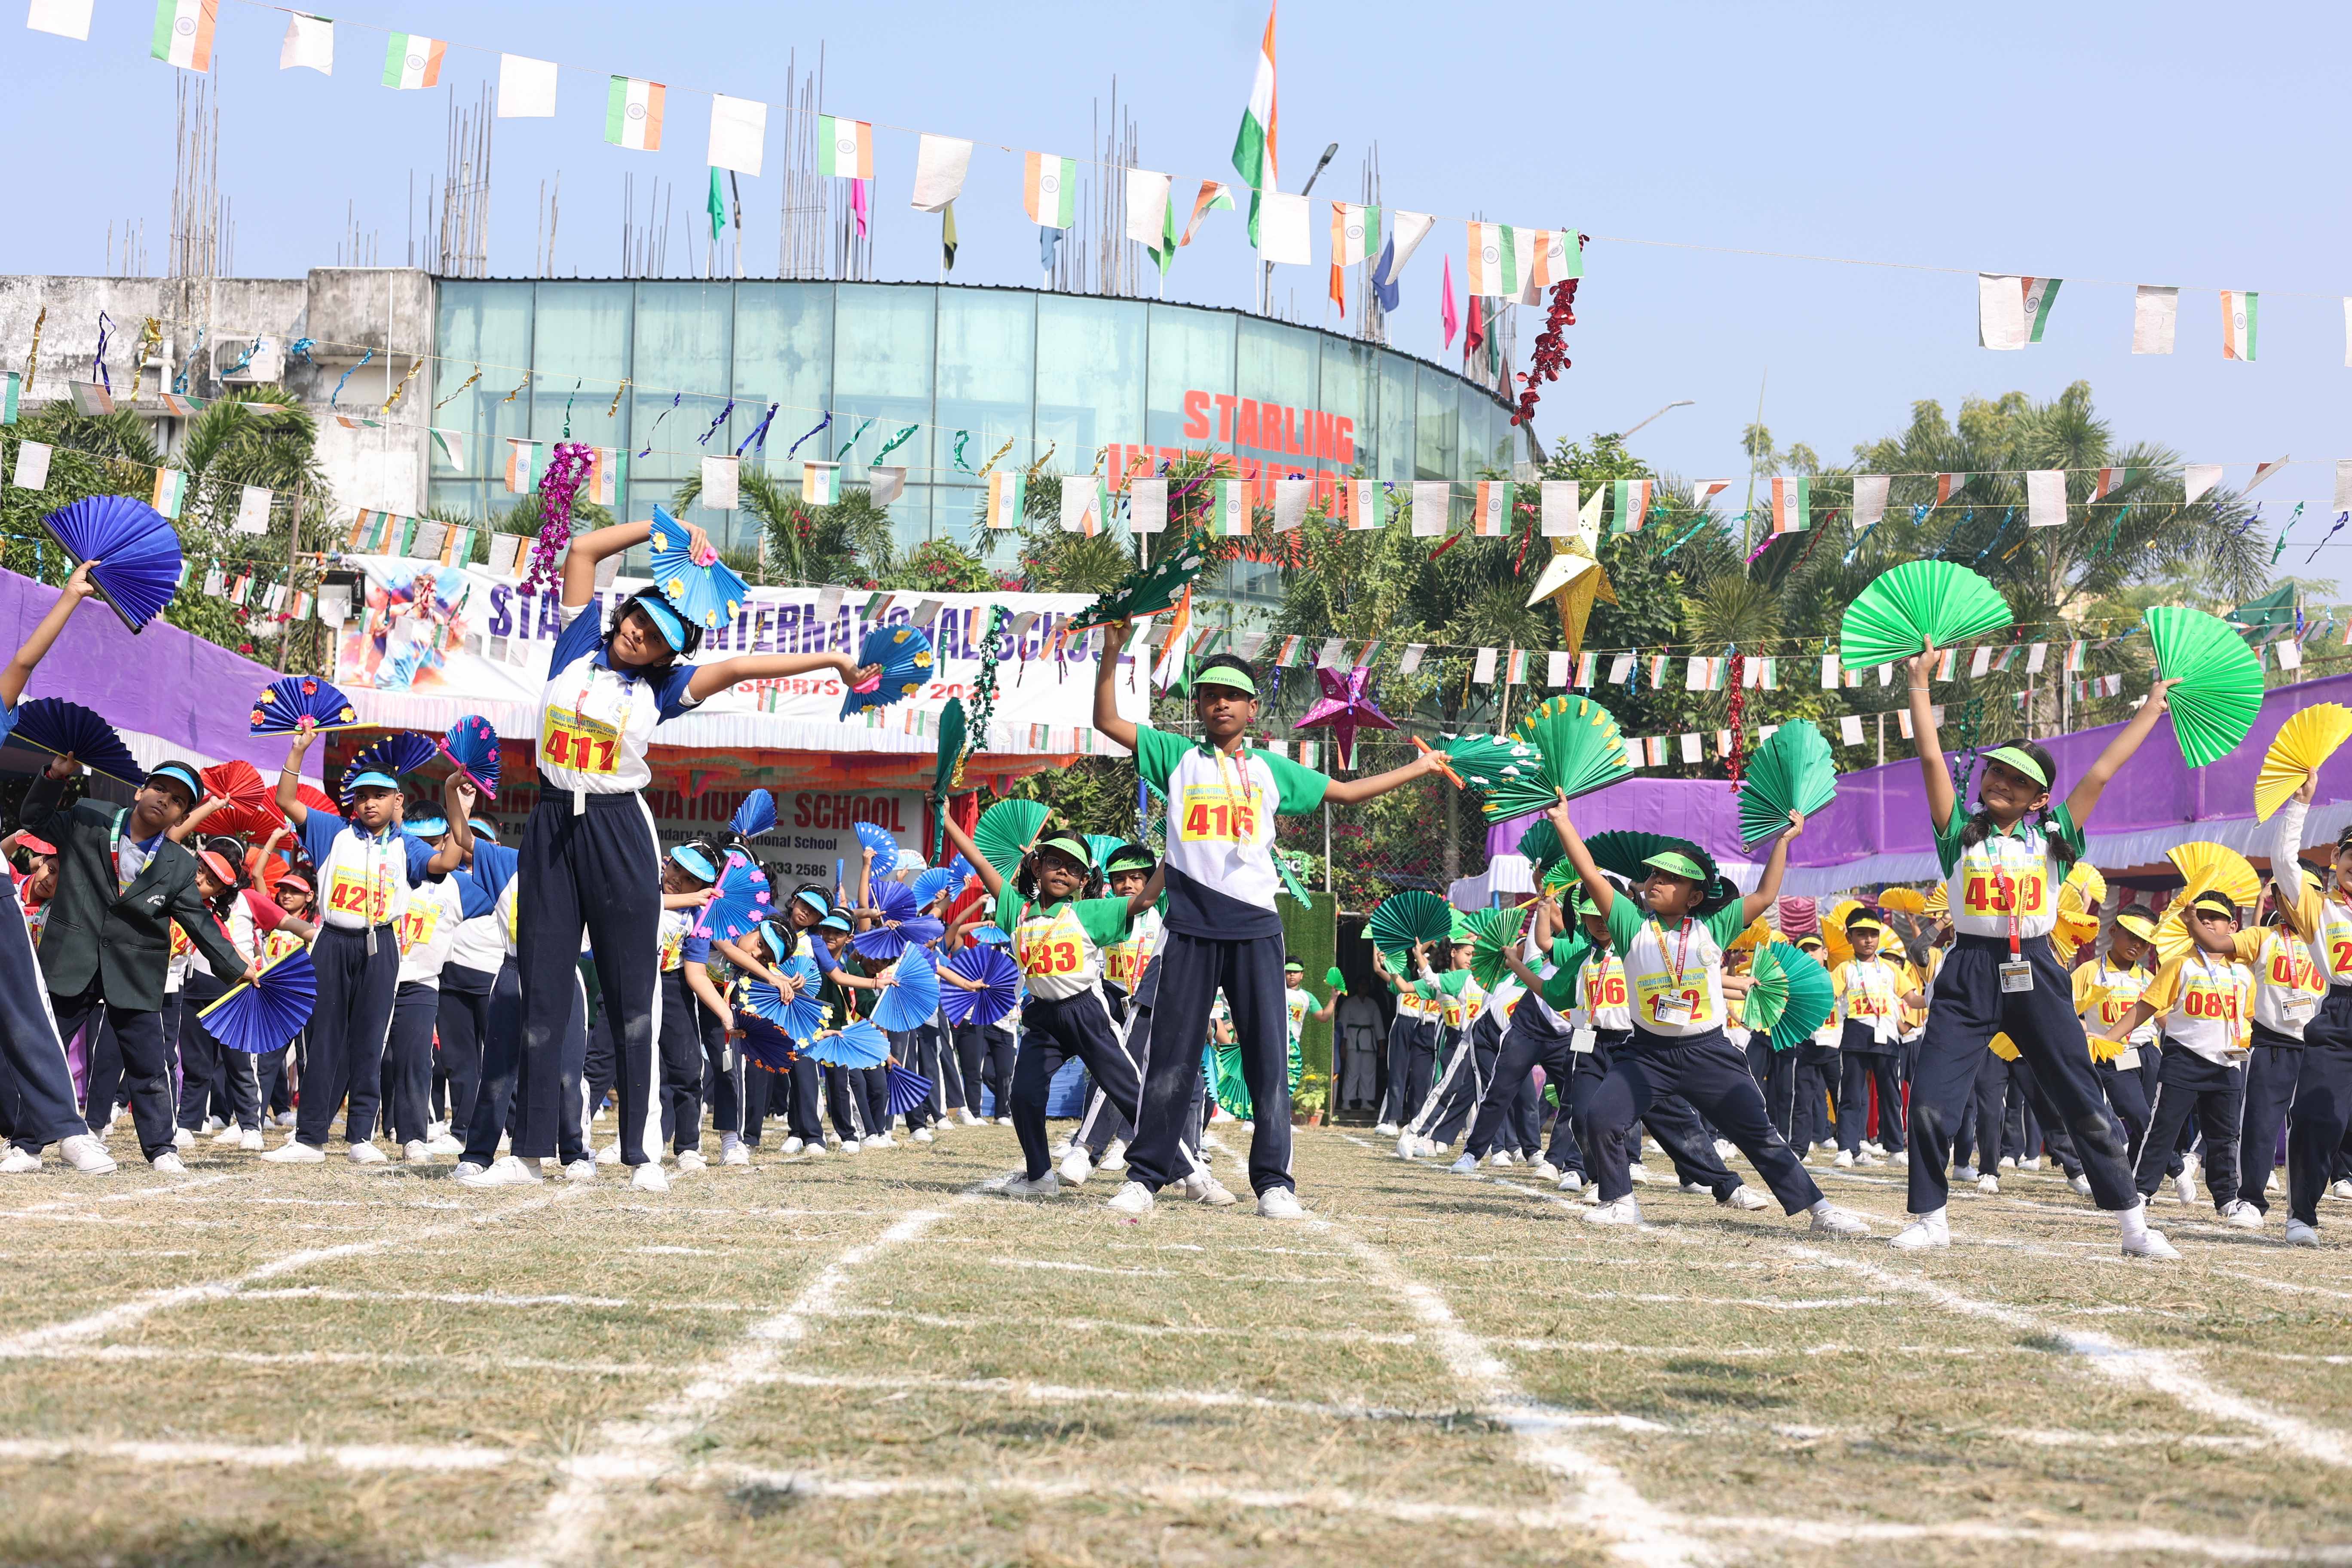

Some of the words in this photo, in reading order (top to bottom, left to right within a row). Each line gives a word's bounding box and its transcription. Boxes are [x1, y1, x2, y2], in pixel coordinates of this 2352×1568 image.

[1183, 390, 1354, 464] STARLING
[738, 679, 840, 696] SPORTS
[545, 729, 615, 771] 411
[795, 792, 906, 832] SCHOOL
[1187, 804, 1254, 837] 416
[795, 836, 837, 850] School
[796, 864, 827, 877] 2586
[331, 883, 386, 917] 425
[1965, 877, 2041, 911] 439
[1637, 979, 1657, 988] STARLING
[1647, 989, 1702, 1022] 12
[2185, 991, 2236, 1019] 085
